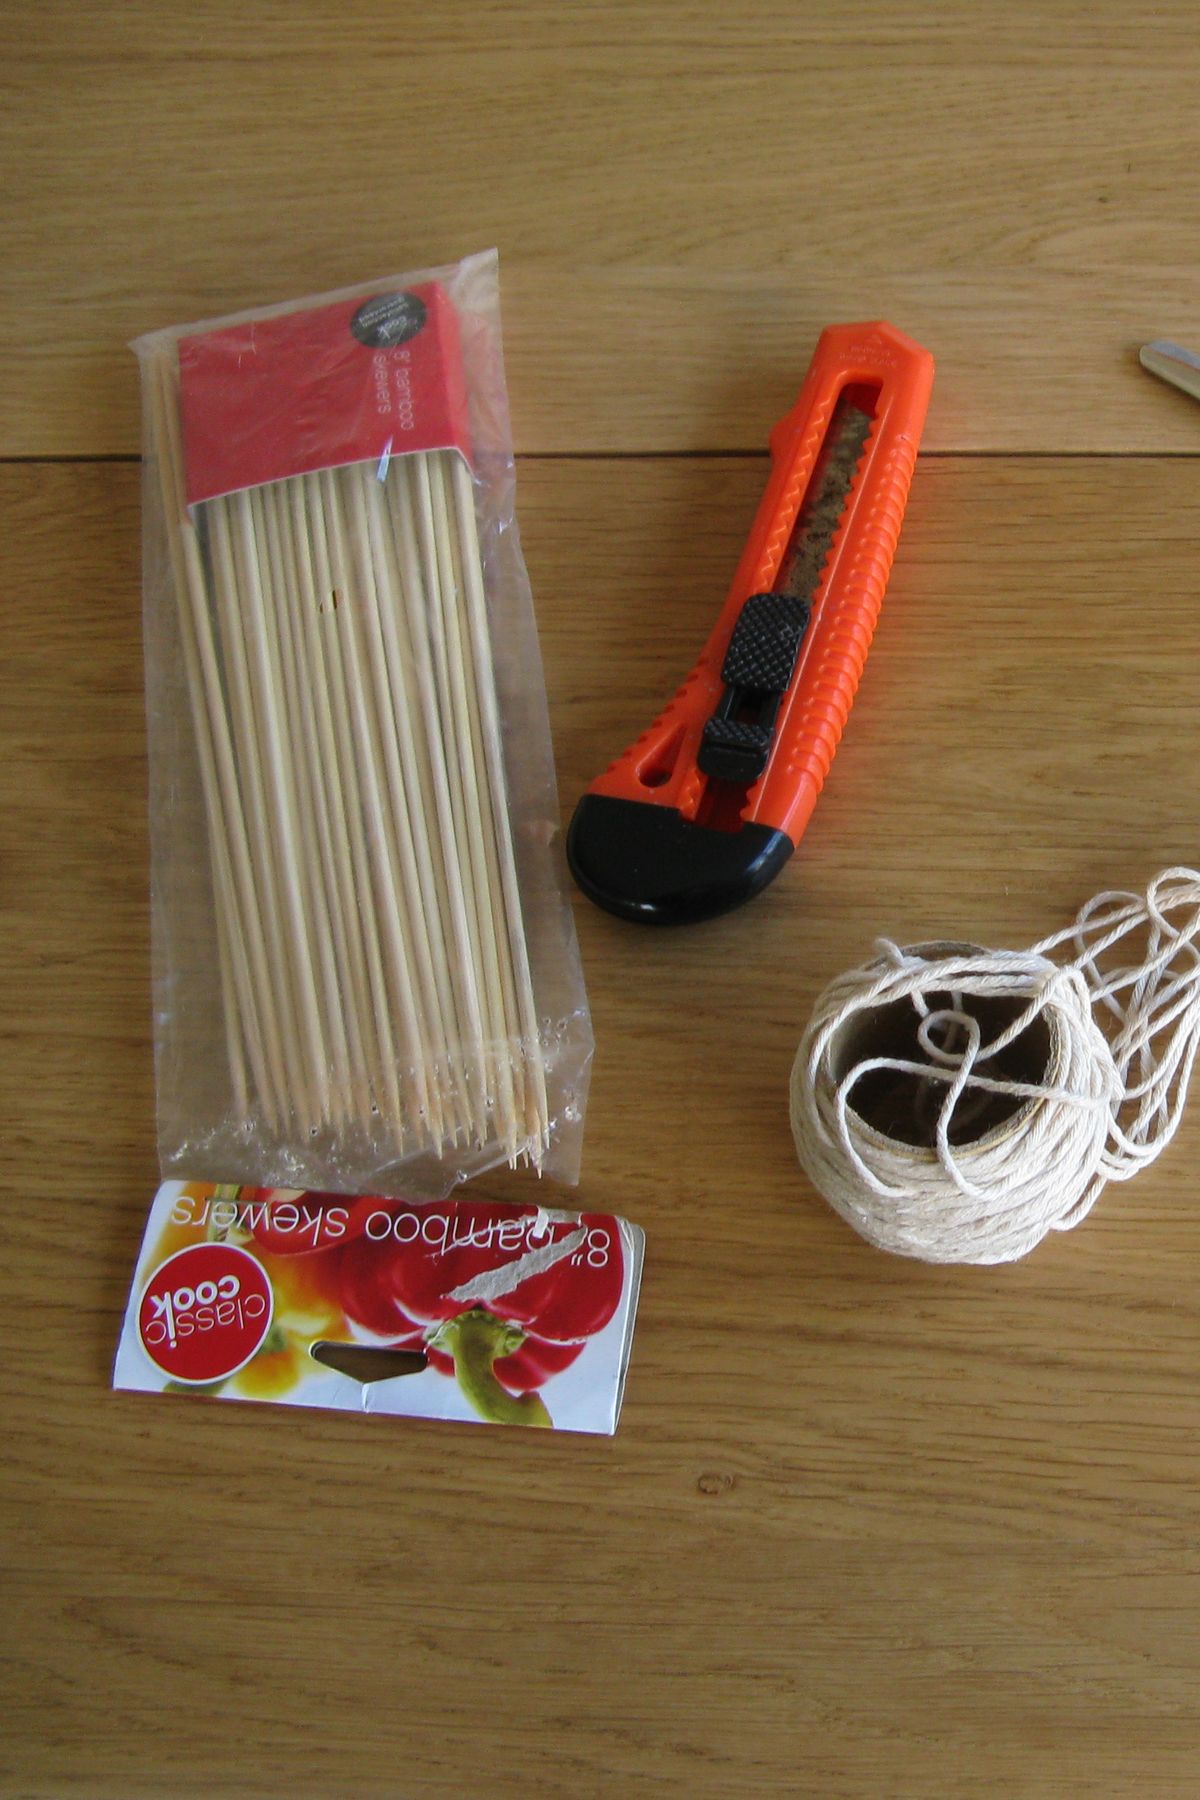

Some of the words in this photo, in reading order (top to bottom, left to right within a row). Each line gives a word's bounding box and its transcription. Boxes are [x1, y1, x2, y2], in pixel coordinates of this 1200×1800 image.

[395, 367, 414, 431] bamboo
[171, 1196, 349, 1246] skewers
[365, 1210, 556, 1256] bamboo
[570, 1228, 611, 1268] 8"
[145, 1293, 266, 1348] classic
[150, 1274, 240, 1336] cook
